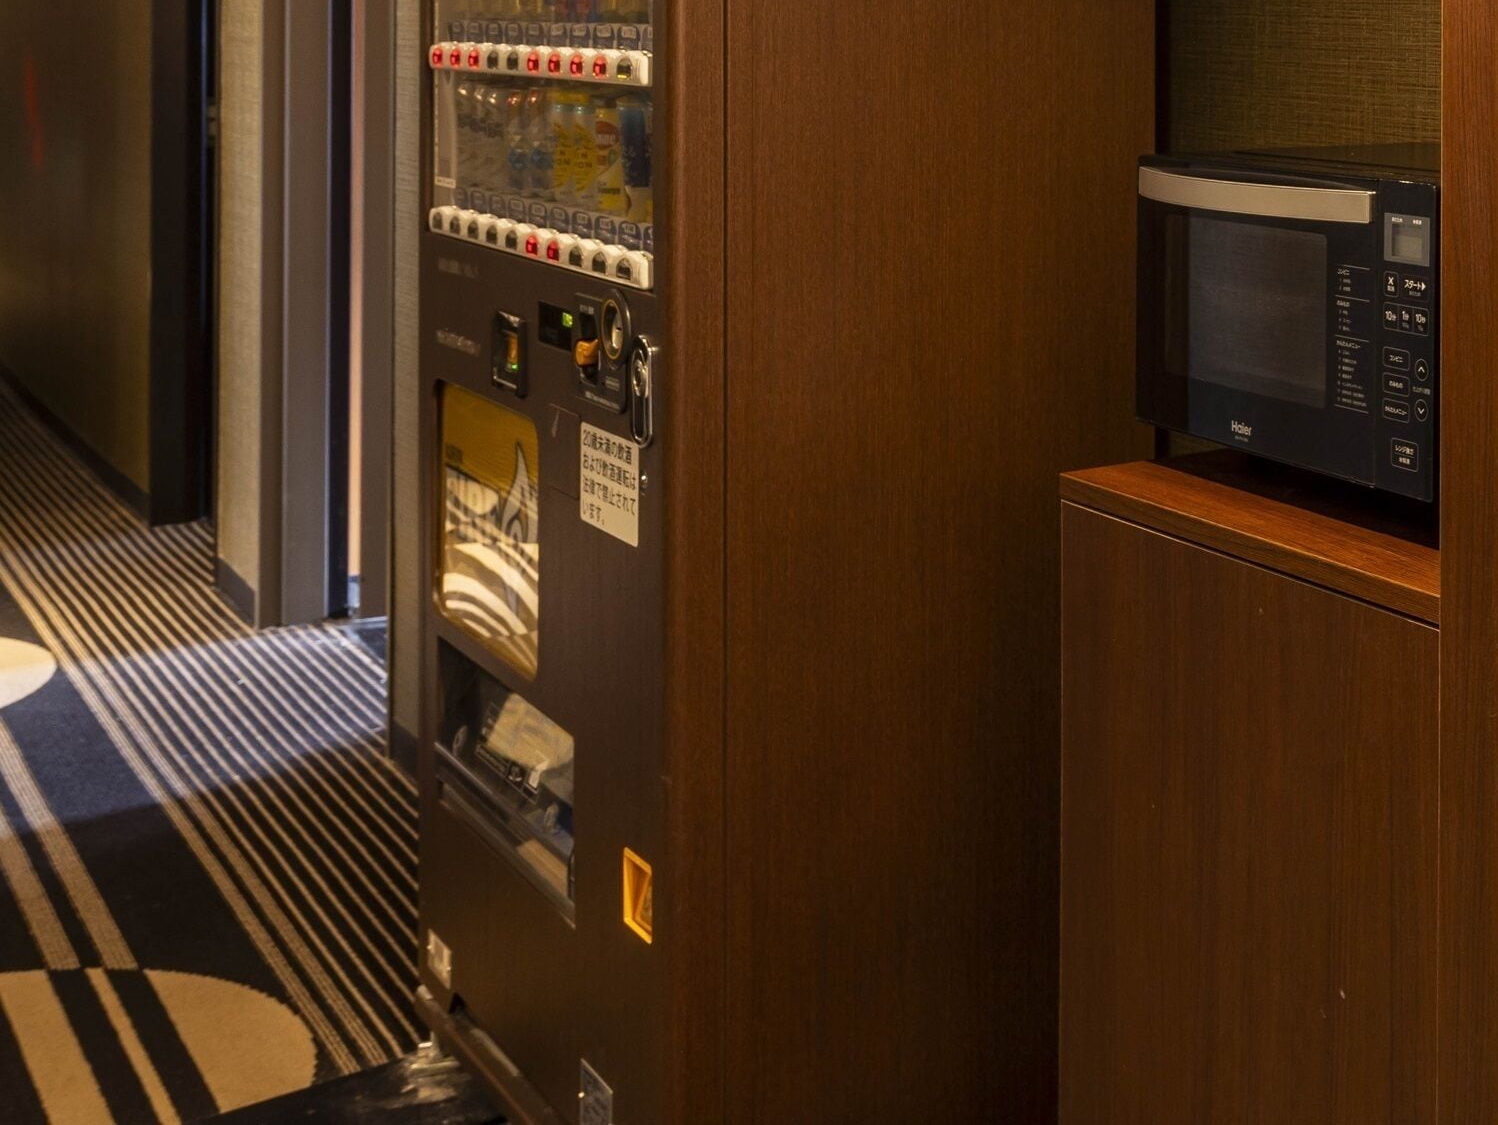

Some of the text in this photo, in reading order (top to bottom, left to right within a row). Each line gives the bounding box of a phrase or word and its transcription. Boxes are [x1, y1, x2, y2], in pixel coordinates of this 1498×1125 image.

[1231, 419, 1252, 436] Haier
[583, 429, 632, 465] 20歳未満の飲酒
[583, 452, 636, 491] および飲酒運転は
